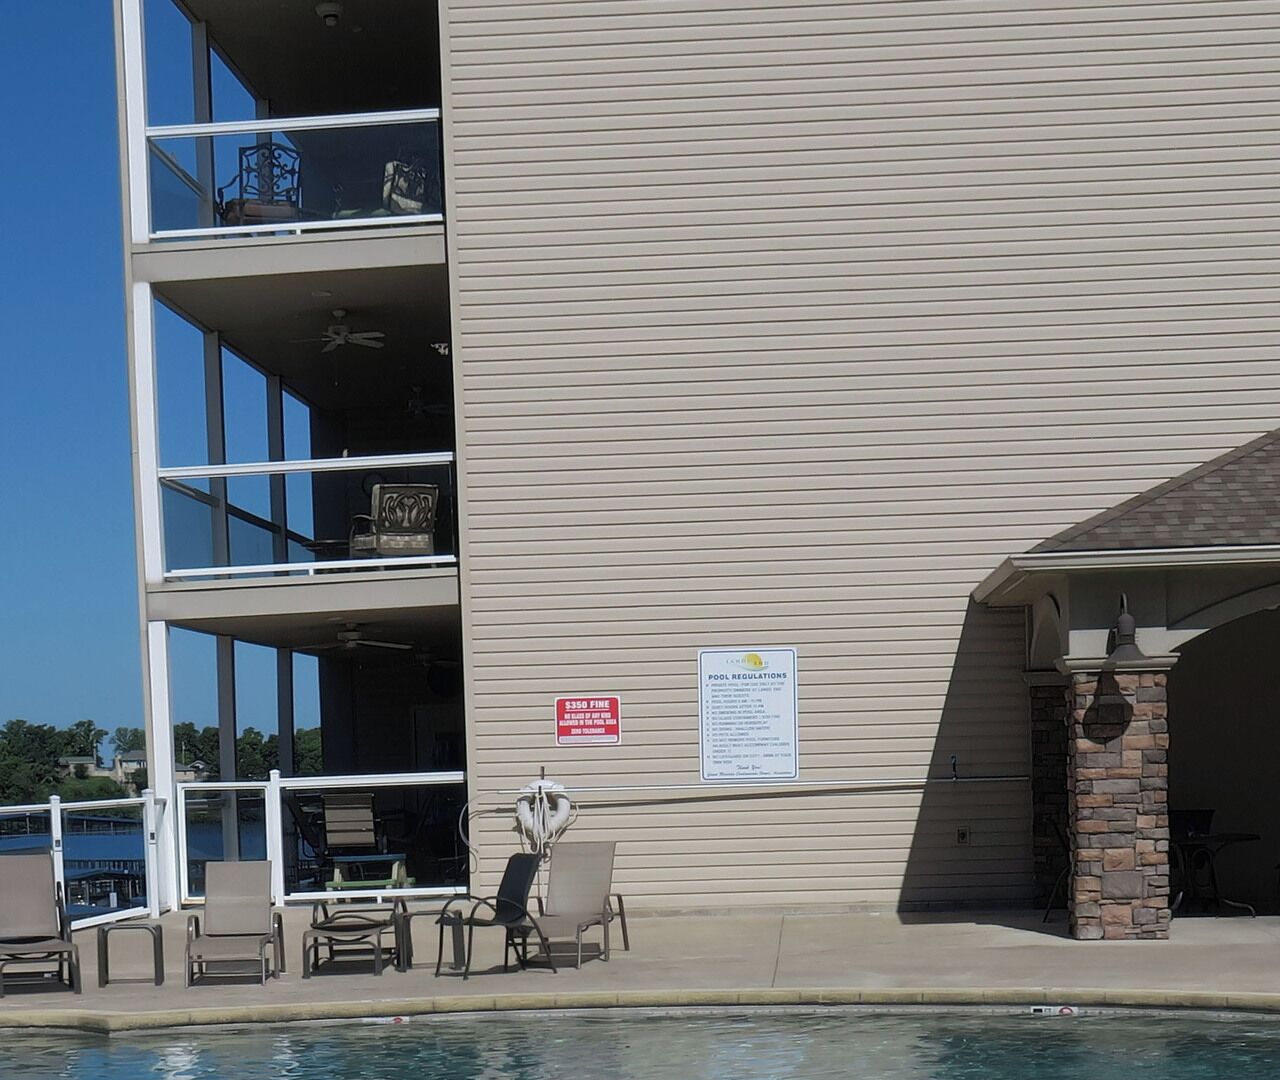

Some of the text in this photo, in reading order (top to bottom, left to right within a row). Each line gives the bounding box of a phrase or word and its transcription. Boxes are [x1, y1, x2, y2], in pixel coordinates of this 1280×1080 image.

[732, 672, 787, 680] REGULATIONS
[565, 700, 610, 709] $350 FINE
